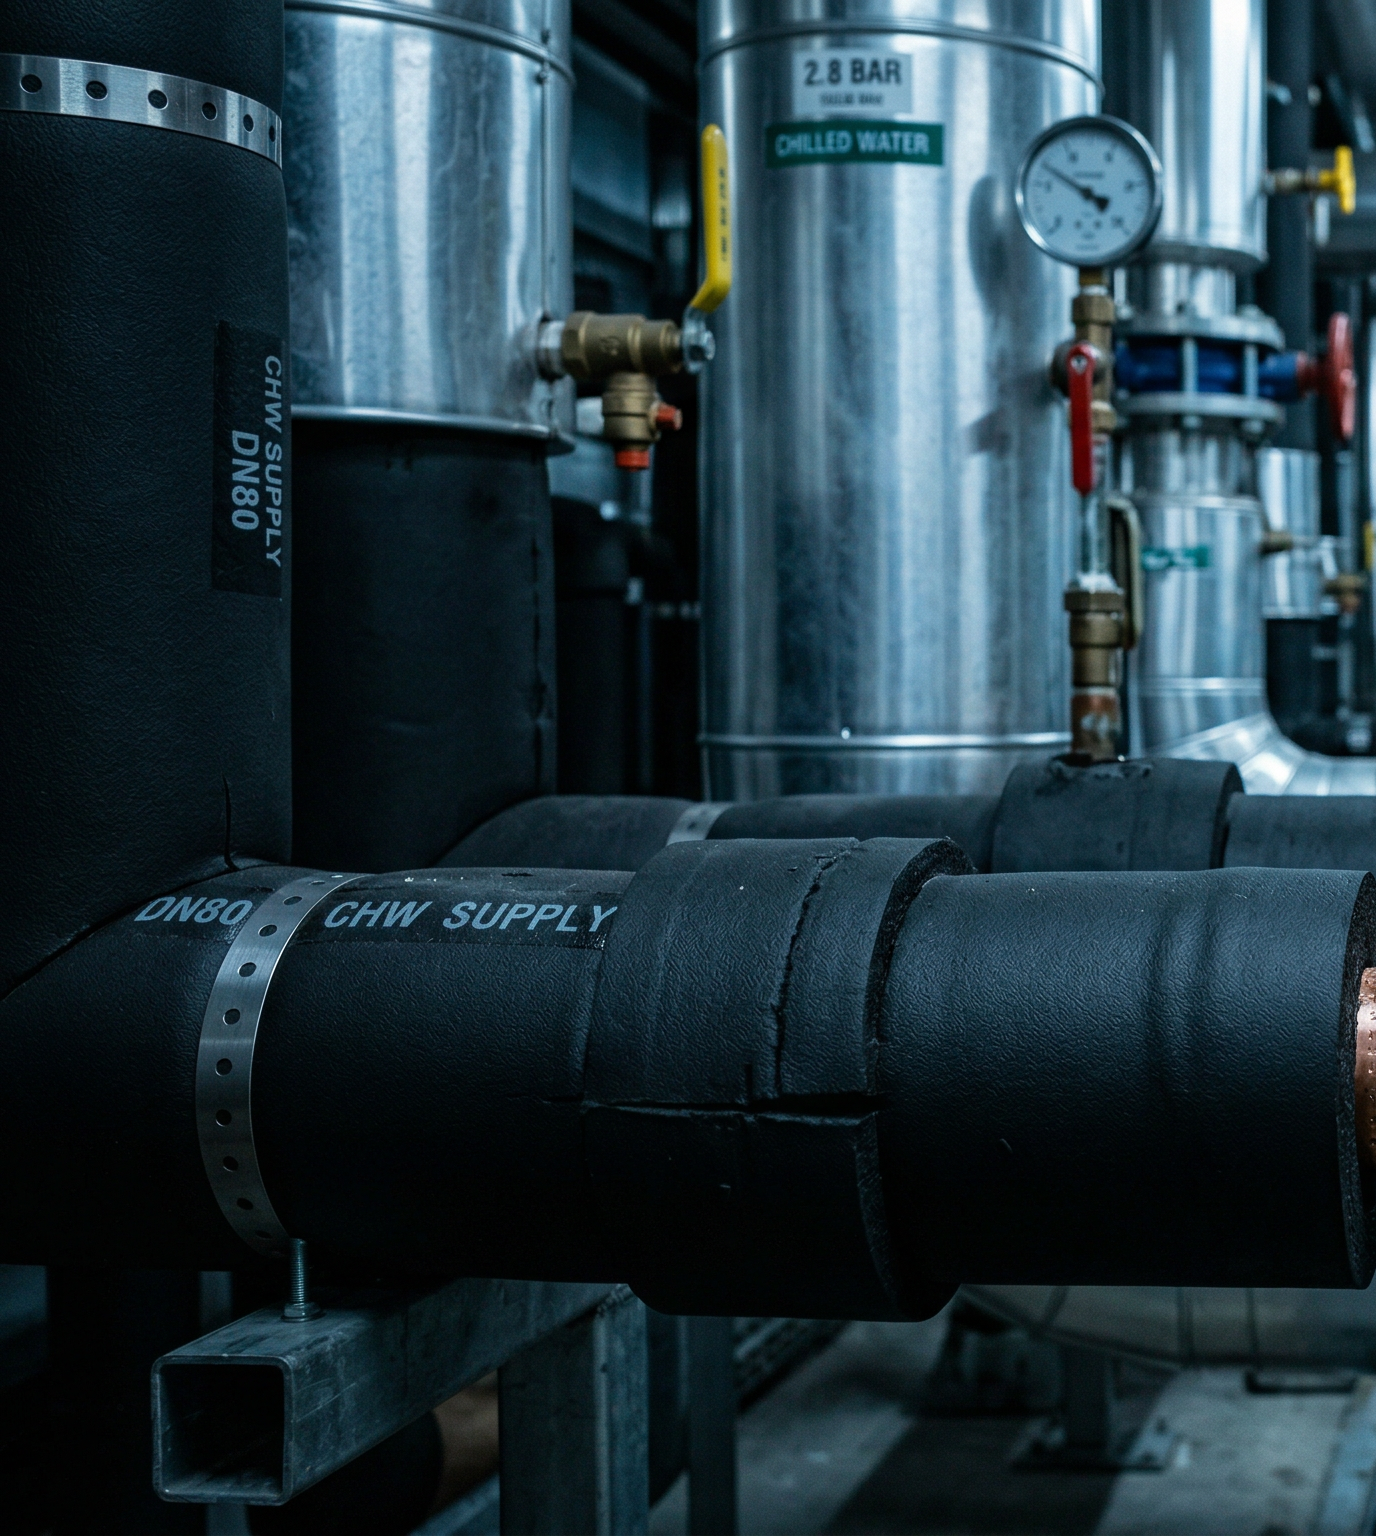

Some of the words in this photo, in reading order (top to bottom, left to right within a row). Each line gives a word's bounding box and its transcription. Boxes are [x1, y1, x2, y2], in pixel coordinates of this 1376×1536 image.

[804, 57, 842, 86] 2.8
[850, 57, 901, 84] BAR
[774, 129, 853, 158] CHILLED
[855, 129, 930, 156] WATER
[264, 355, 282, 434] CHW
[231, 430, 260, 531] DN80
[264, 441, 282, 568] SUPPLY
[133, 896, 253, 926] DN80
[323, 901, 433, 929] CHW
[442, 901, 618, 933] SUPPLY
